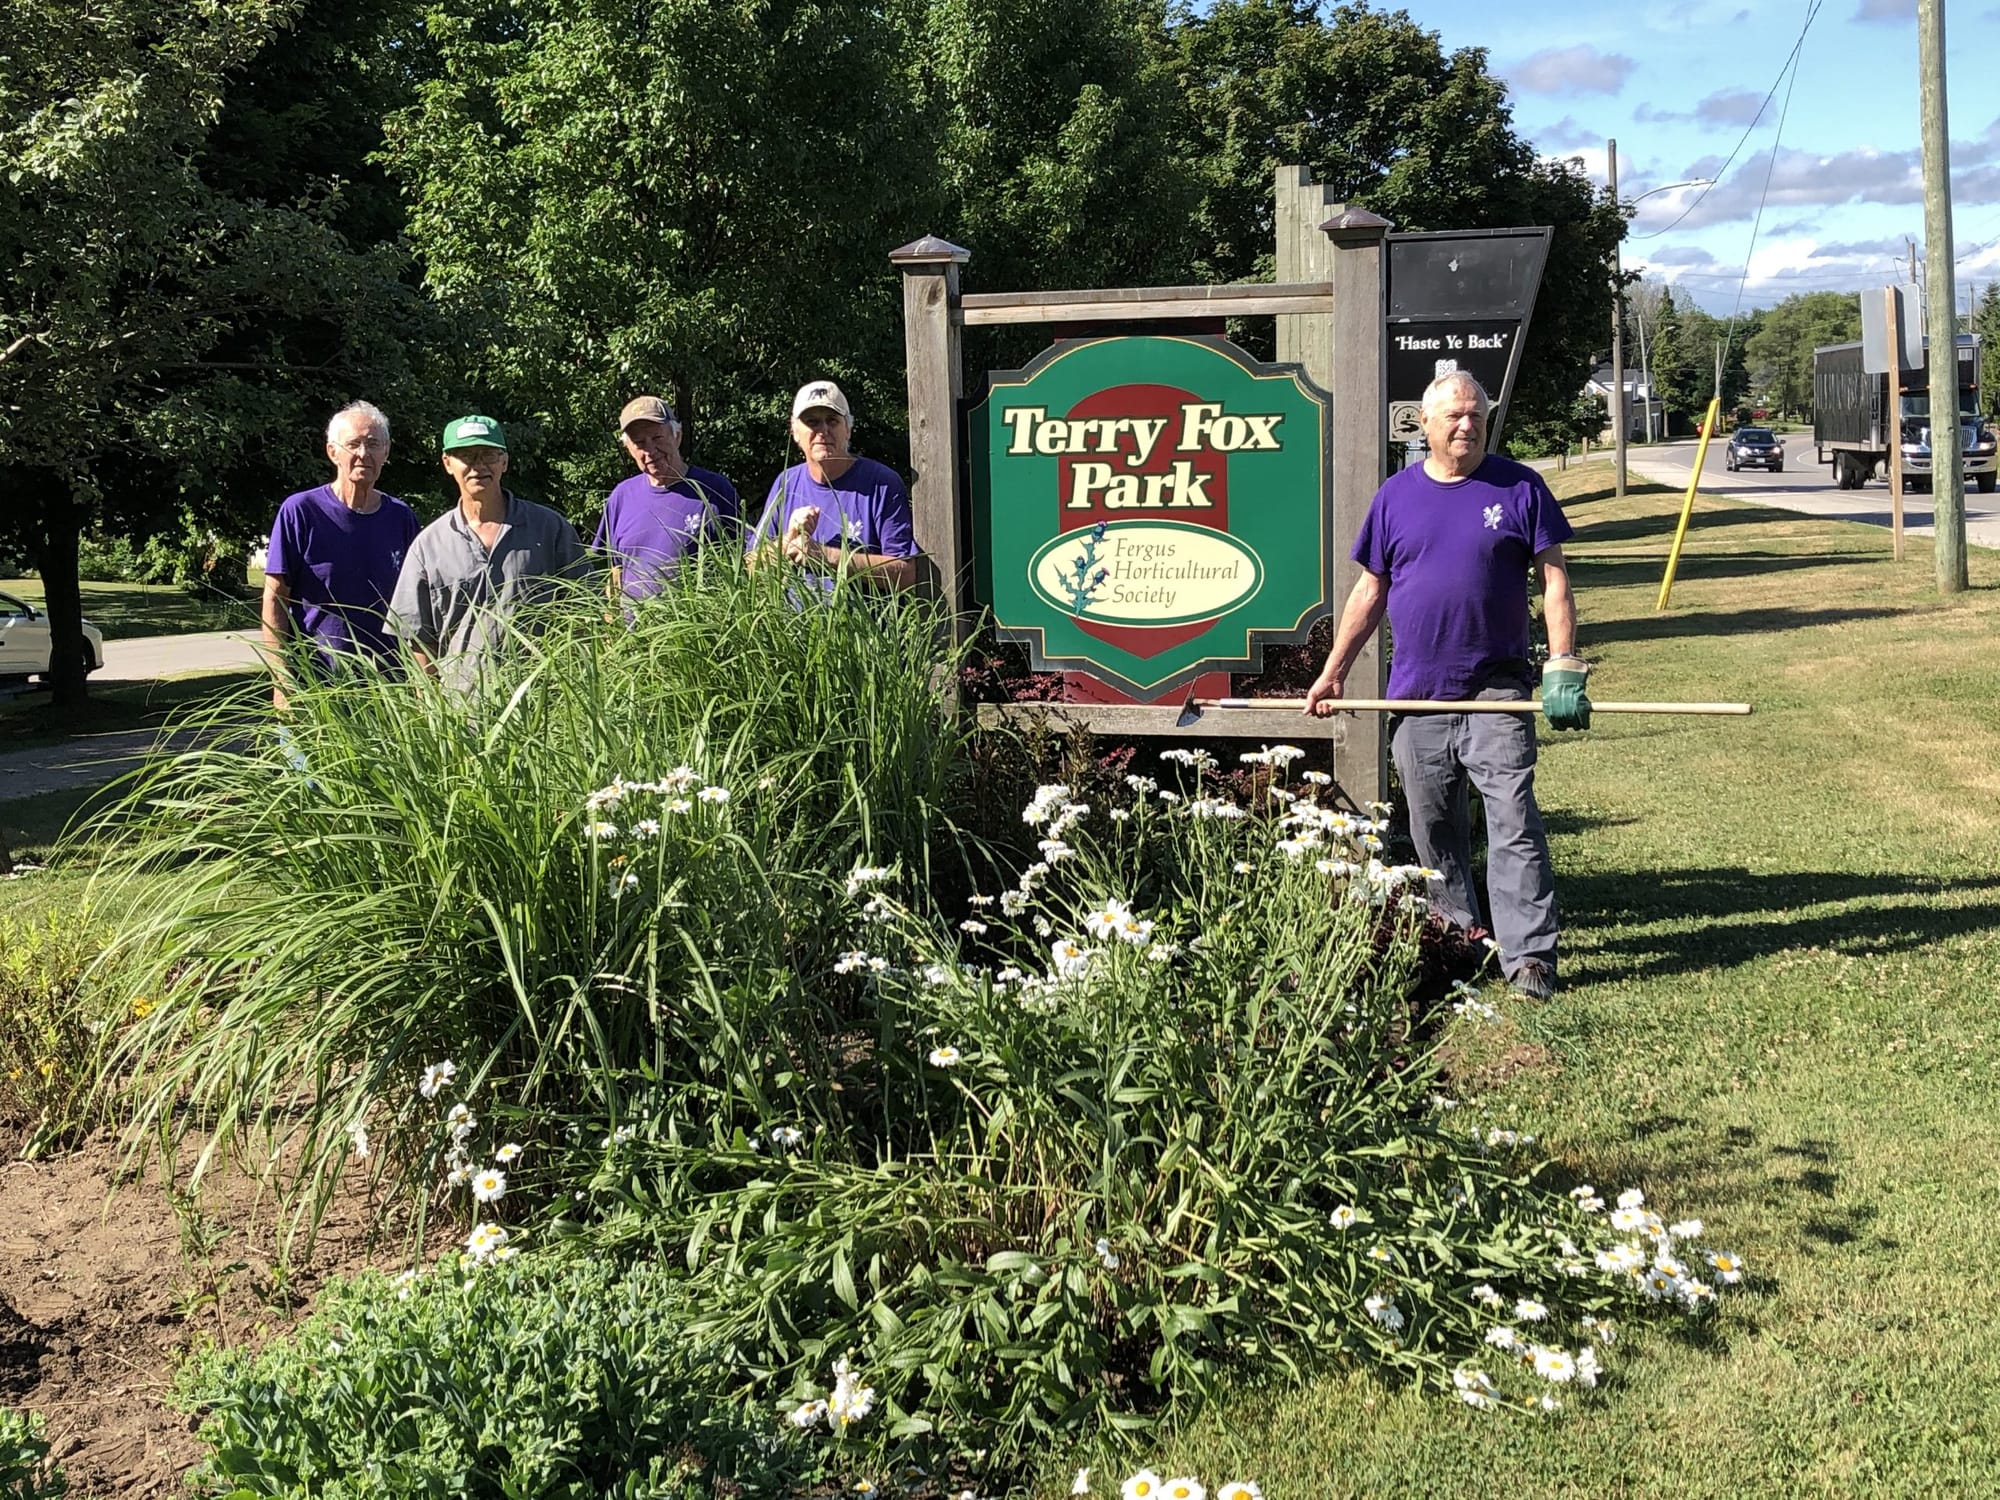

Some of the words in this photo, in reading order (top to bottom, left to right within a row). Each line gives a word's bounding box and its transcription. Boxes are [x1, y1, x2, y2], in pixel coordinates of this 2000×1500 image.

[1445, 335, 1463, 349] Ye
[1003, 407, 1168, 466] Terry
[1176, 403, 1283, 451] Fox
[1067, 461, 1213, 509] Park
[1114, 537, 1176, 562] Fergus
[1113, 559, 1240, 580] Horticultural
[1111, 583, 1177, 609] Society
